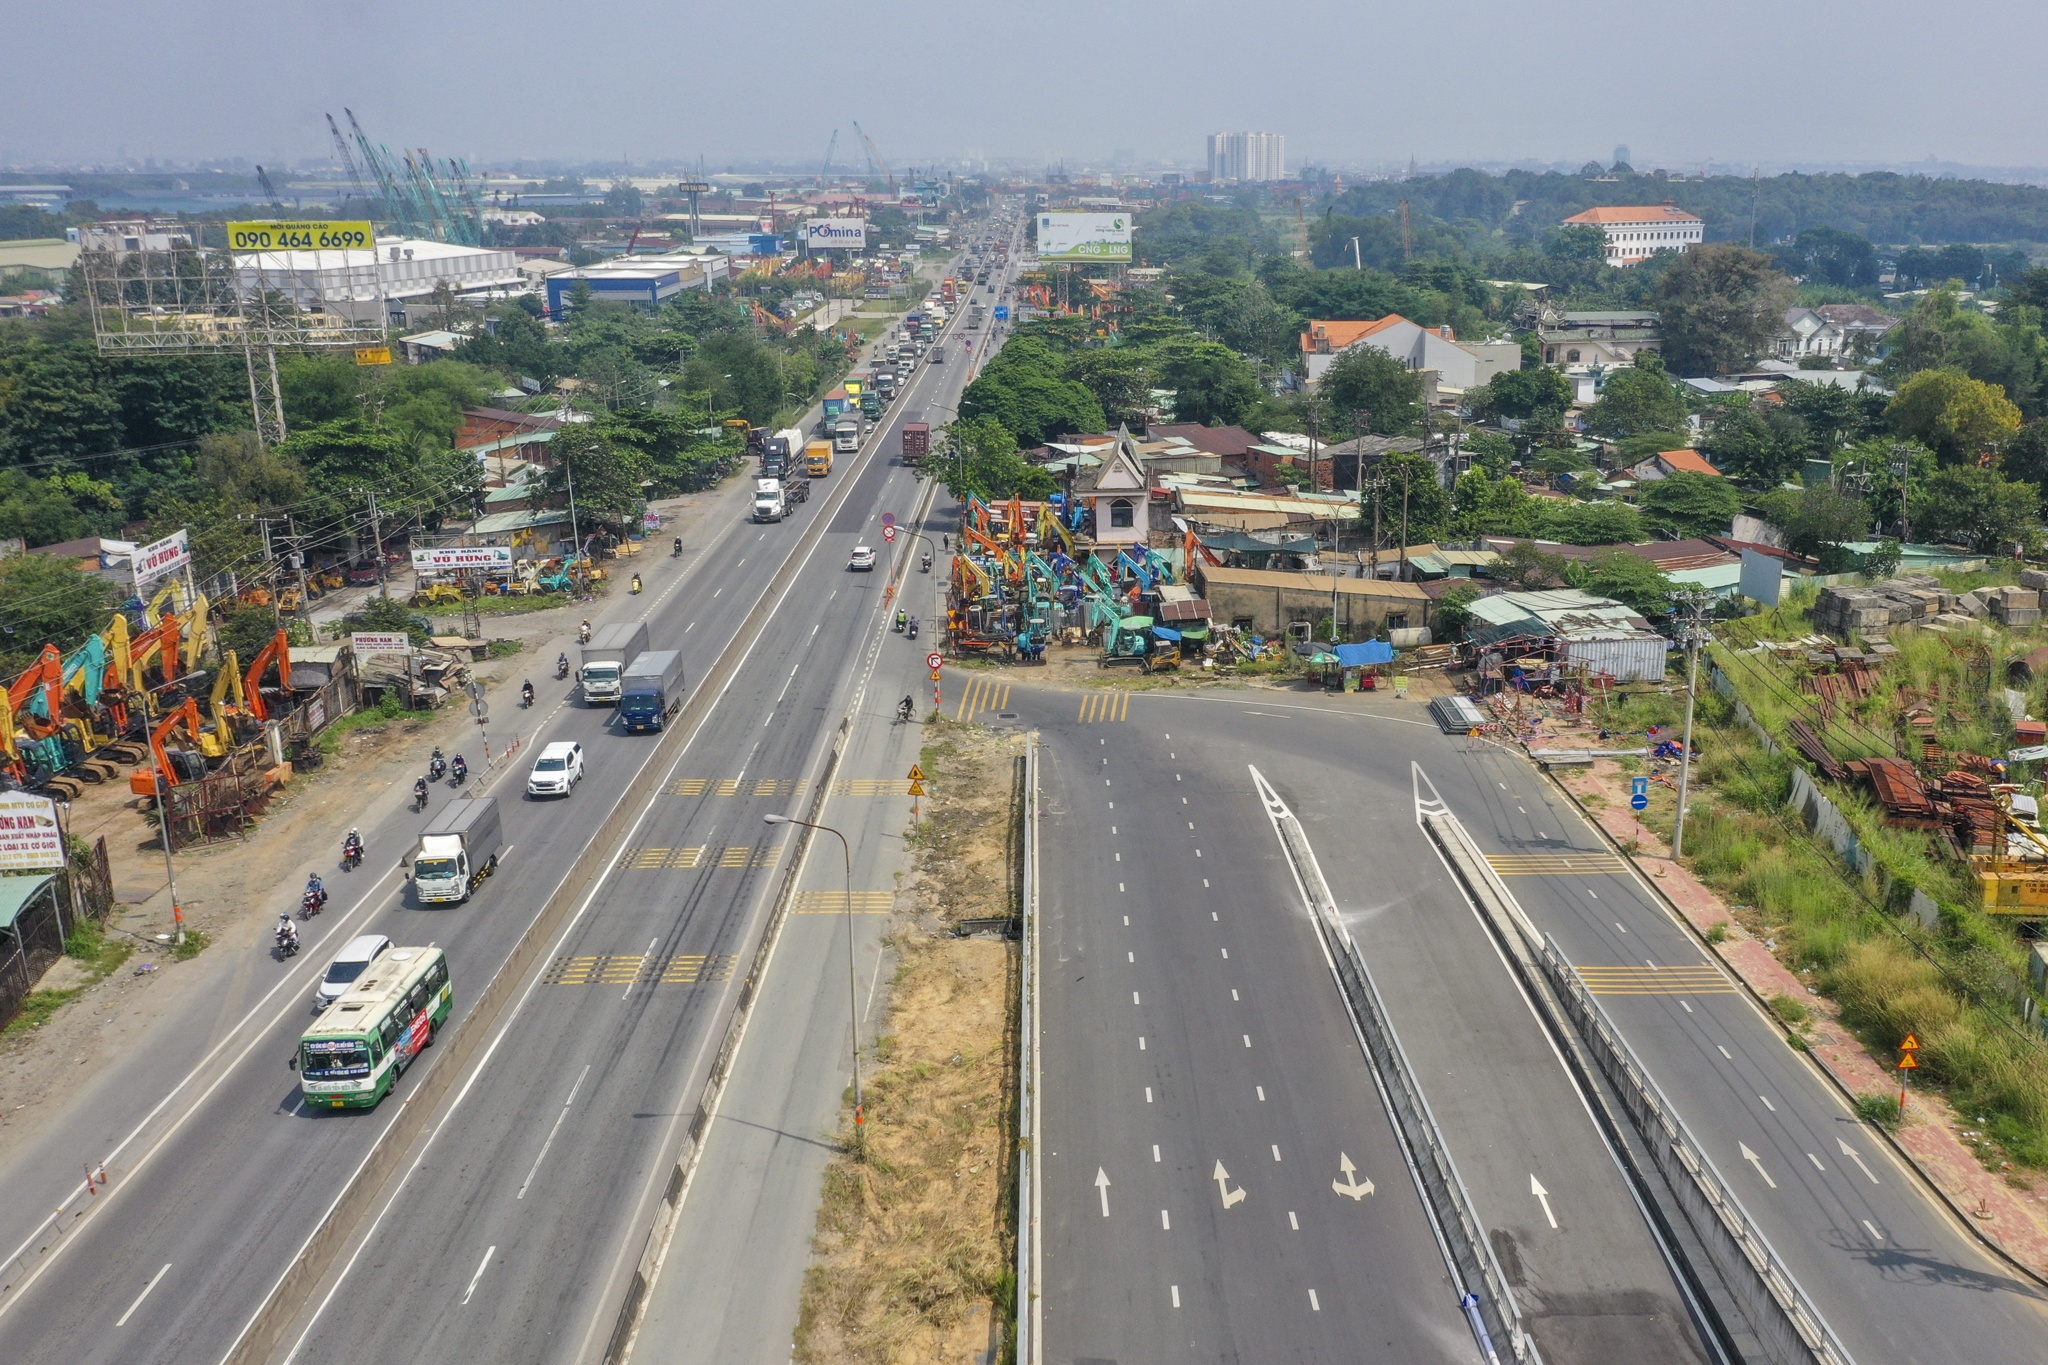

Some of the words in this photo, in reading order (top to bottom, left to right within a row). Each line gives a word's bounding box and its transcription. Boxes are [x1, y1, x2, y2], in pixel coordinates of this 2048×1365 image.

[236, 232, 271, 248] 090
[278, 232, 312, 247] 464
[319, 231, 365, 247] 6699
[1078, 245, 1101, 253] CNG
[1109, 245, 1128, 253] LNG
[433, 555, 451, 563] VŨ
[456, 554, 492, 562] HÙNG
[17, 816, 35, 829] NAM
